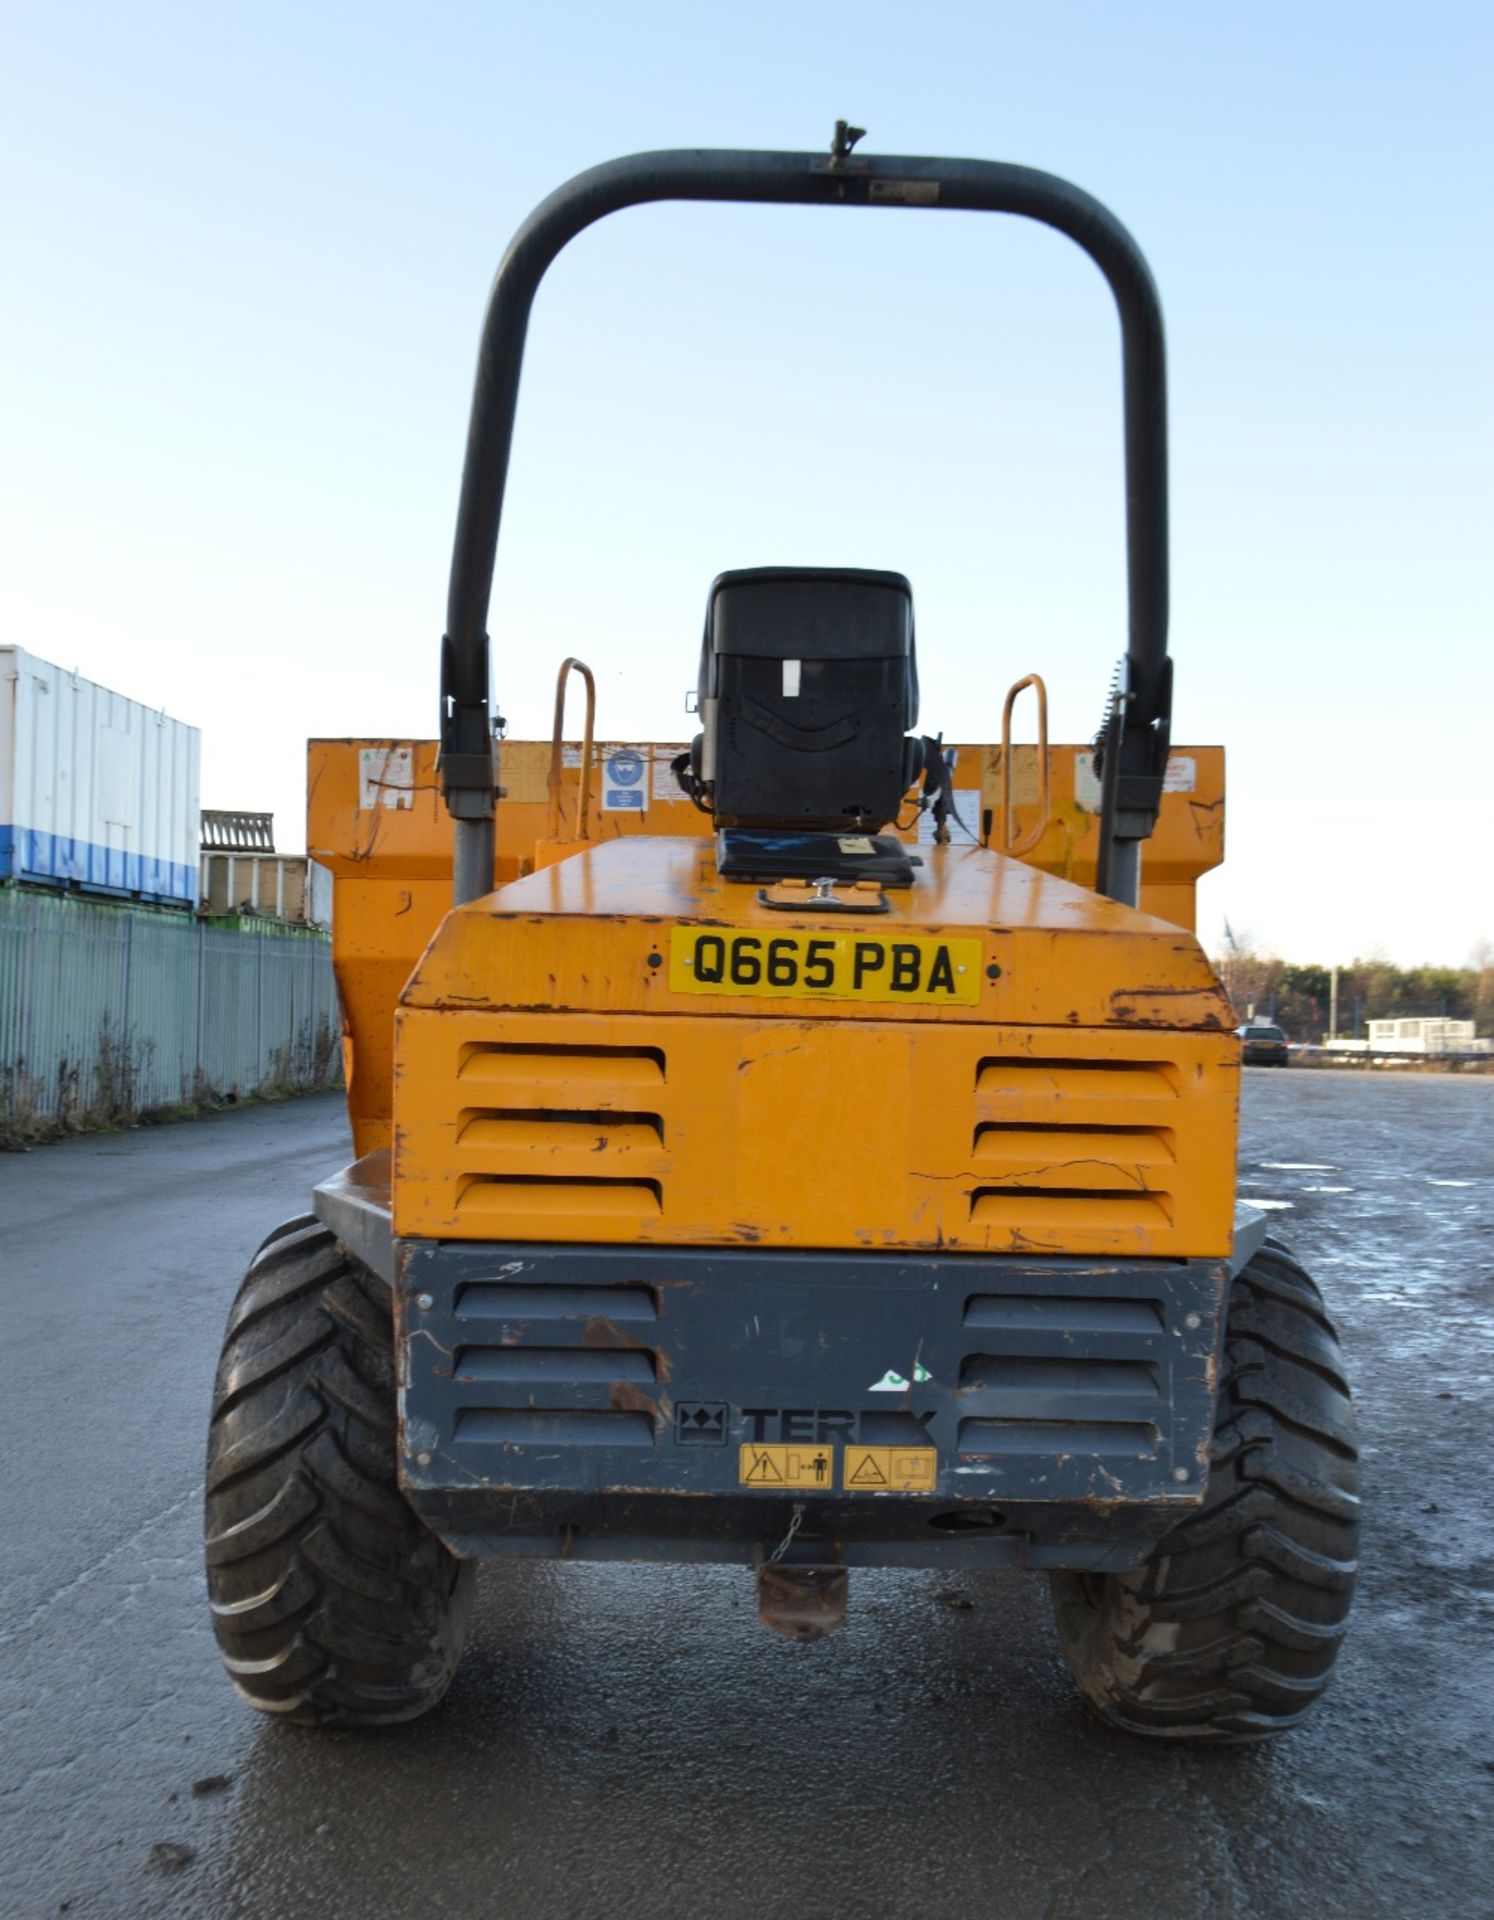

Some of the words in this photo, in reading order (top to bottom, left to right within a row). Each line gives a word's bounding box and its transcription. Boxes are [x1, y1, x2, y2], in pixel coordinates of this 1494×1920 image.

[694, 935, 836, 988] Q665
[853, 942, 956, 994] PBA
[741, 1408, 938, 1446] TERX
